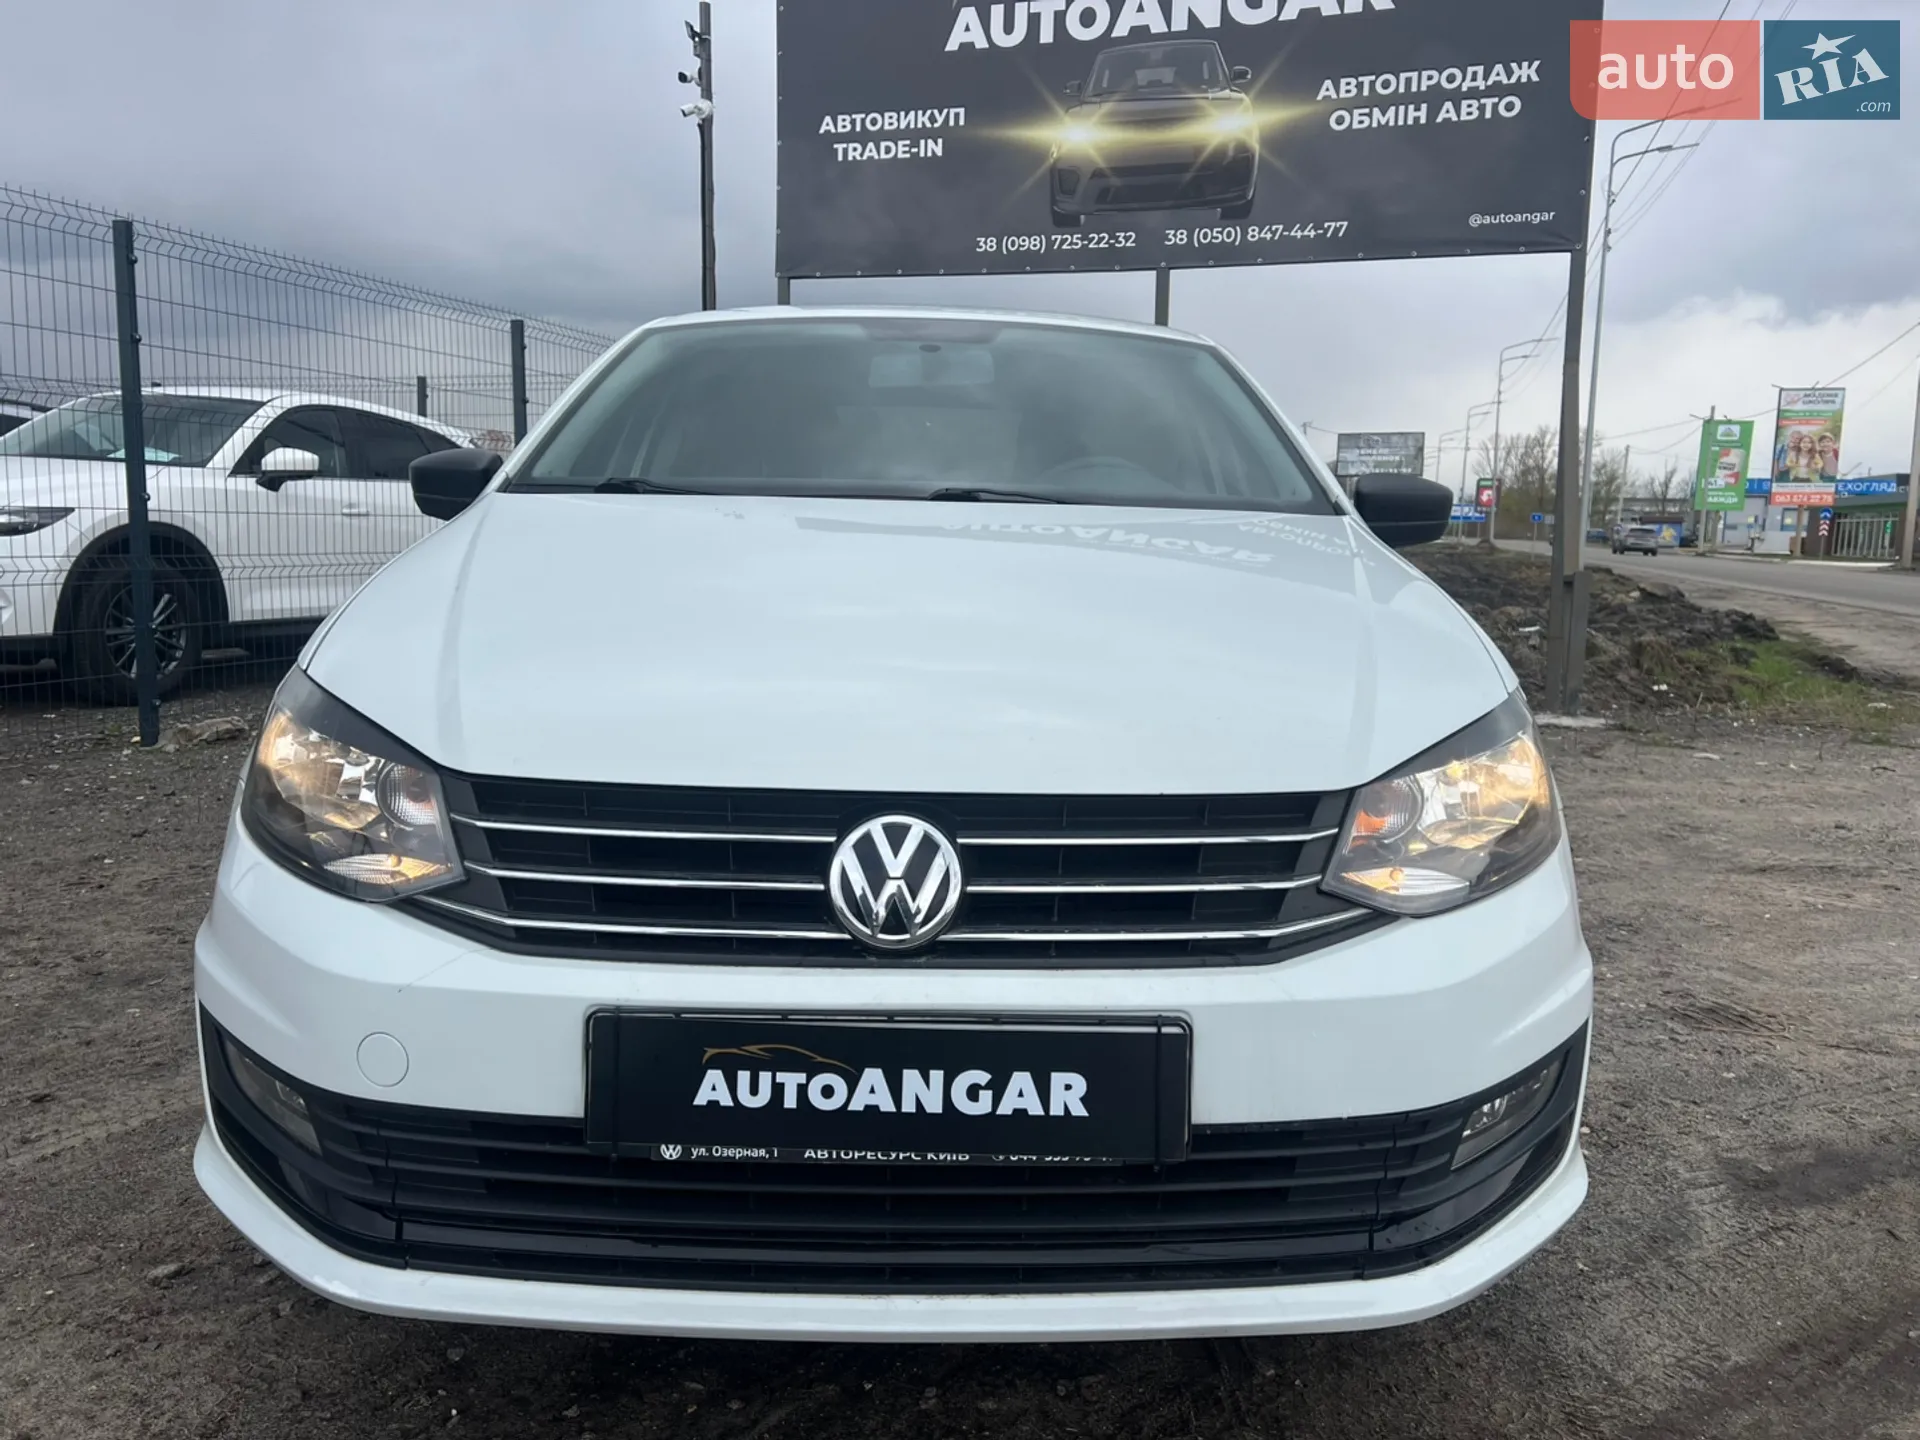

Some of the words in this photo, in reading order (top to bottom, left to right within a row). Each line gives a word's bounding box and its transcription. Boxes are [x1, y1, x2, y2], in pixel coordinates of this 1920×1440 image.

[944, 0, 1395, 51] AUTOAN
[1316, 60, 1542, 100] АВТОПРОДАЖ
[819, 107, 966, 134] АВТОВИКУП
[1329, 103, 1428, 131] ОБМІН
[1435, 95, 1522, 123] АВТО
[833, 138, 943, 162] TRADE-IN
[1468, 211, 1556, 227] @autoangar
[976, 236, 997, 251] 38
[1001, 234, 1046, 254] (098)
[1051, 232, 1137, 250] 725-22-32
[1164, 229, 1188, 245] 38
[1193, 226, 1241, 247] (050)
[1247, 221, 1348, 241] 847-44-77
[1837, 481, 1897, 493] ЕХОГЛЯД
[693, 1067, 1090, 1117] AUTOANGAR
[690, 1147, 709, 1158] ул.
[712, 1145, 769, 1160] Озерная,
